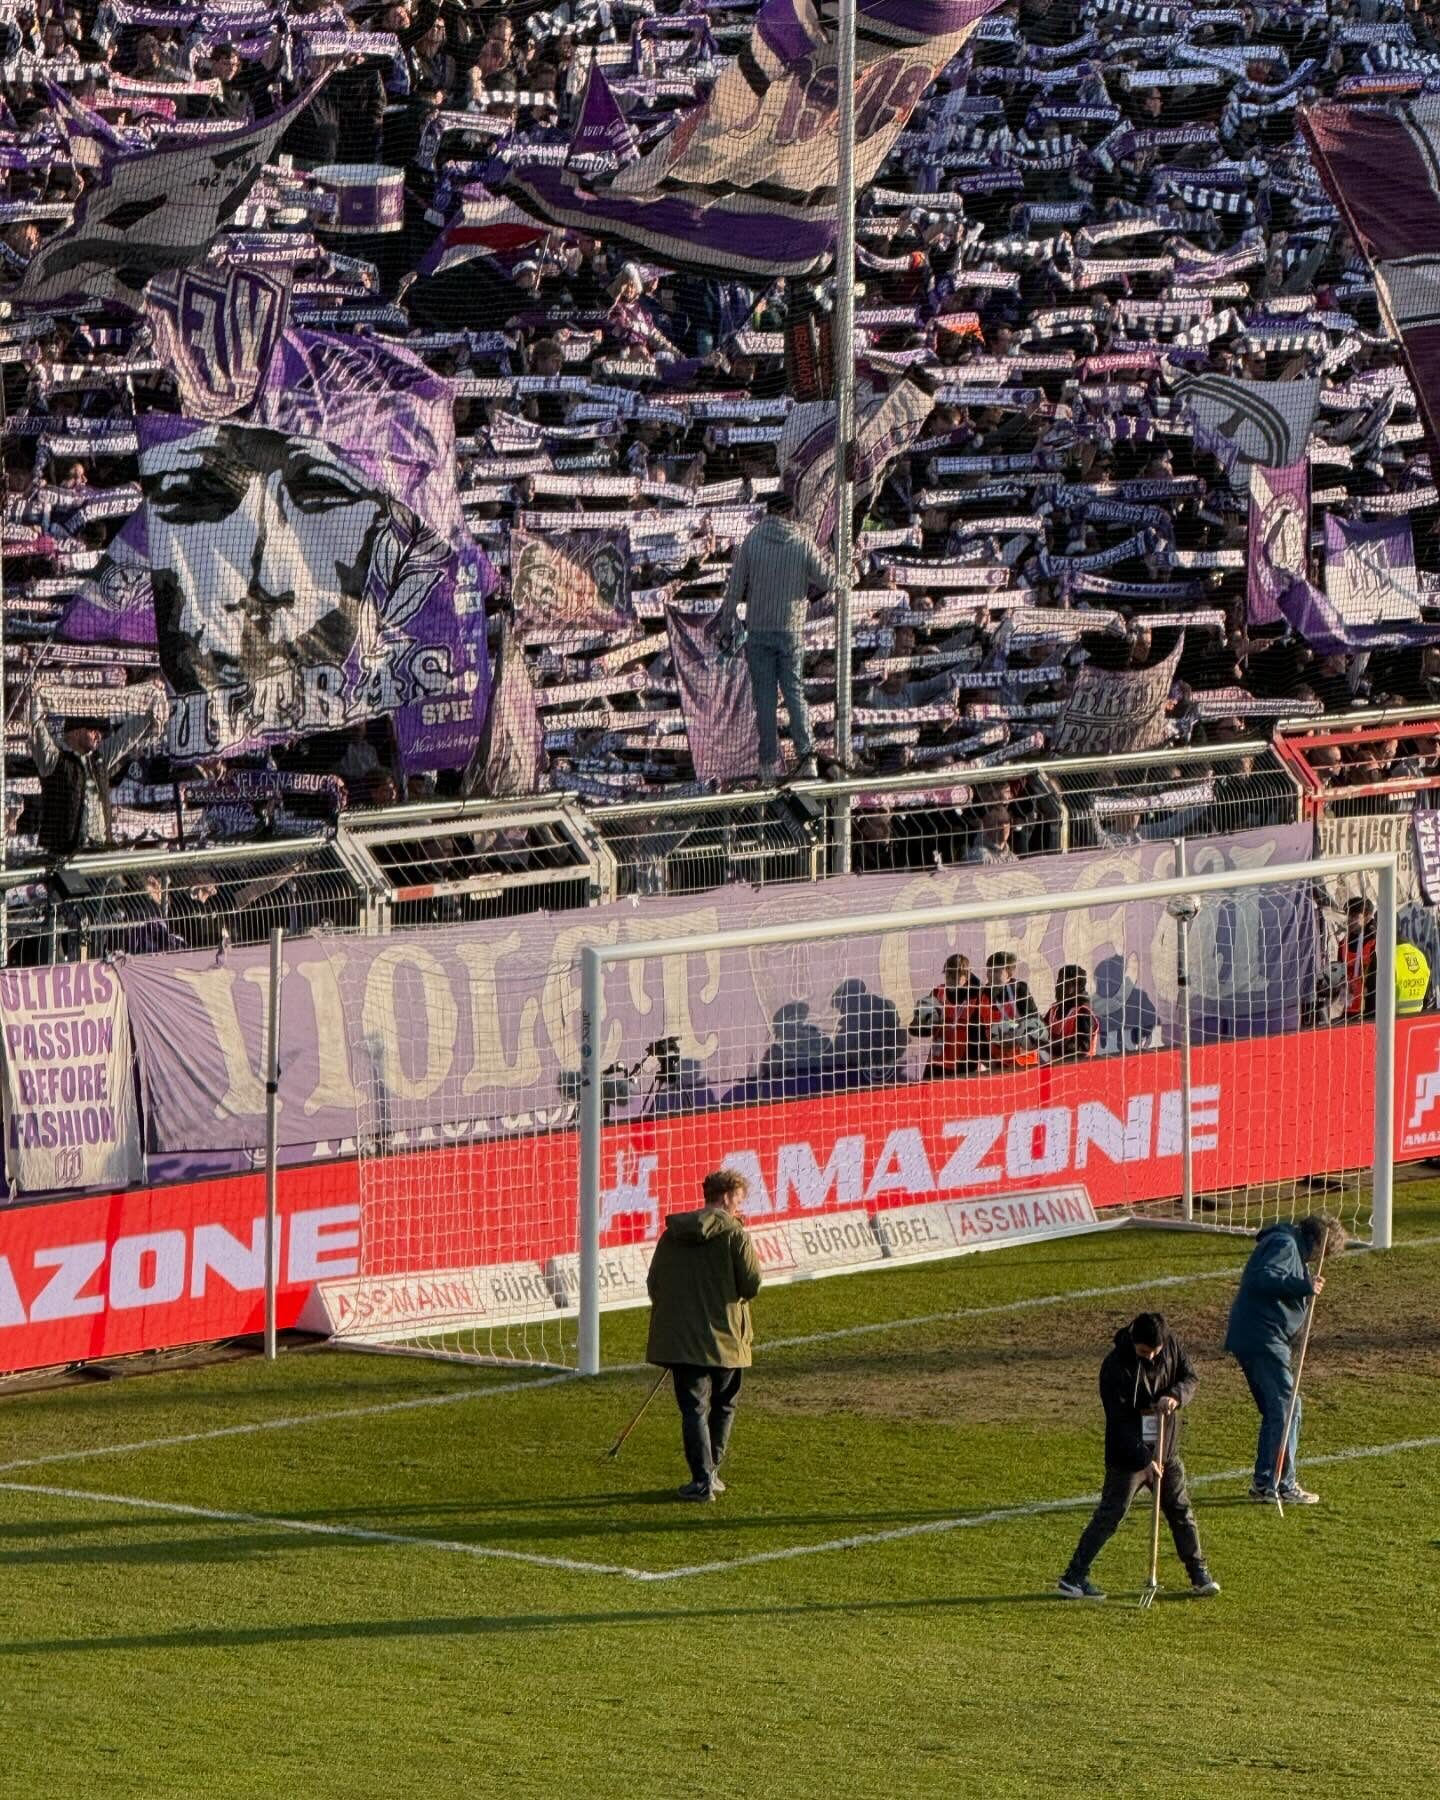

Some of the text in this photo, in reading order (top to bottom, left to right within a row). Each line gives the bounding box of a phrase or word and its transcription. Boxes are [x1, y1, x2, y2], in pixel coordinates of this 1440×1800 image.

[168, 638, 453, 757] ULTRAS
[0, 963, 113, 1011] ULTRAS
[174, 907, 721, 1121] VIOLET
[6, 1016, 113, 1061] PASSION
[18, 1063, 108, 1106] BEFORE
[9, 1106, 118, 1150] FASHION
[719, 1085, 1221, 1217] AMAZONE
[801, 1215, 940, 1257] BÜROMÖBEL
[958, 1194, 1086, 1237] ASSMANN
[336, 1281, 475, 1319] ASSMANN
